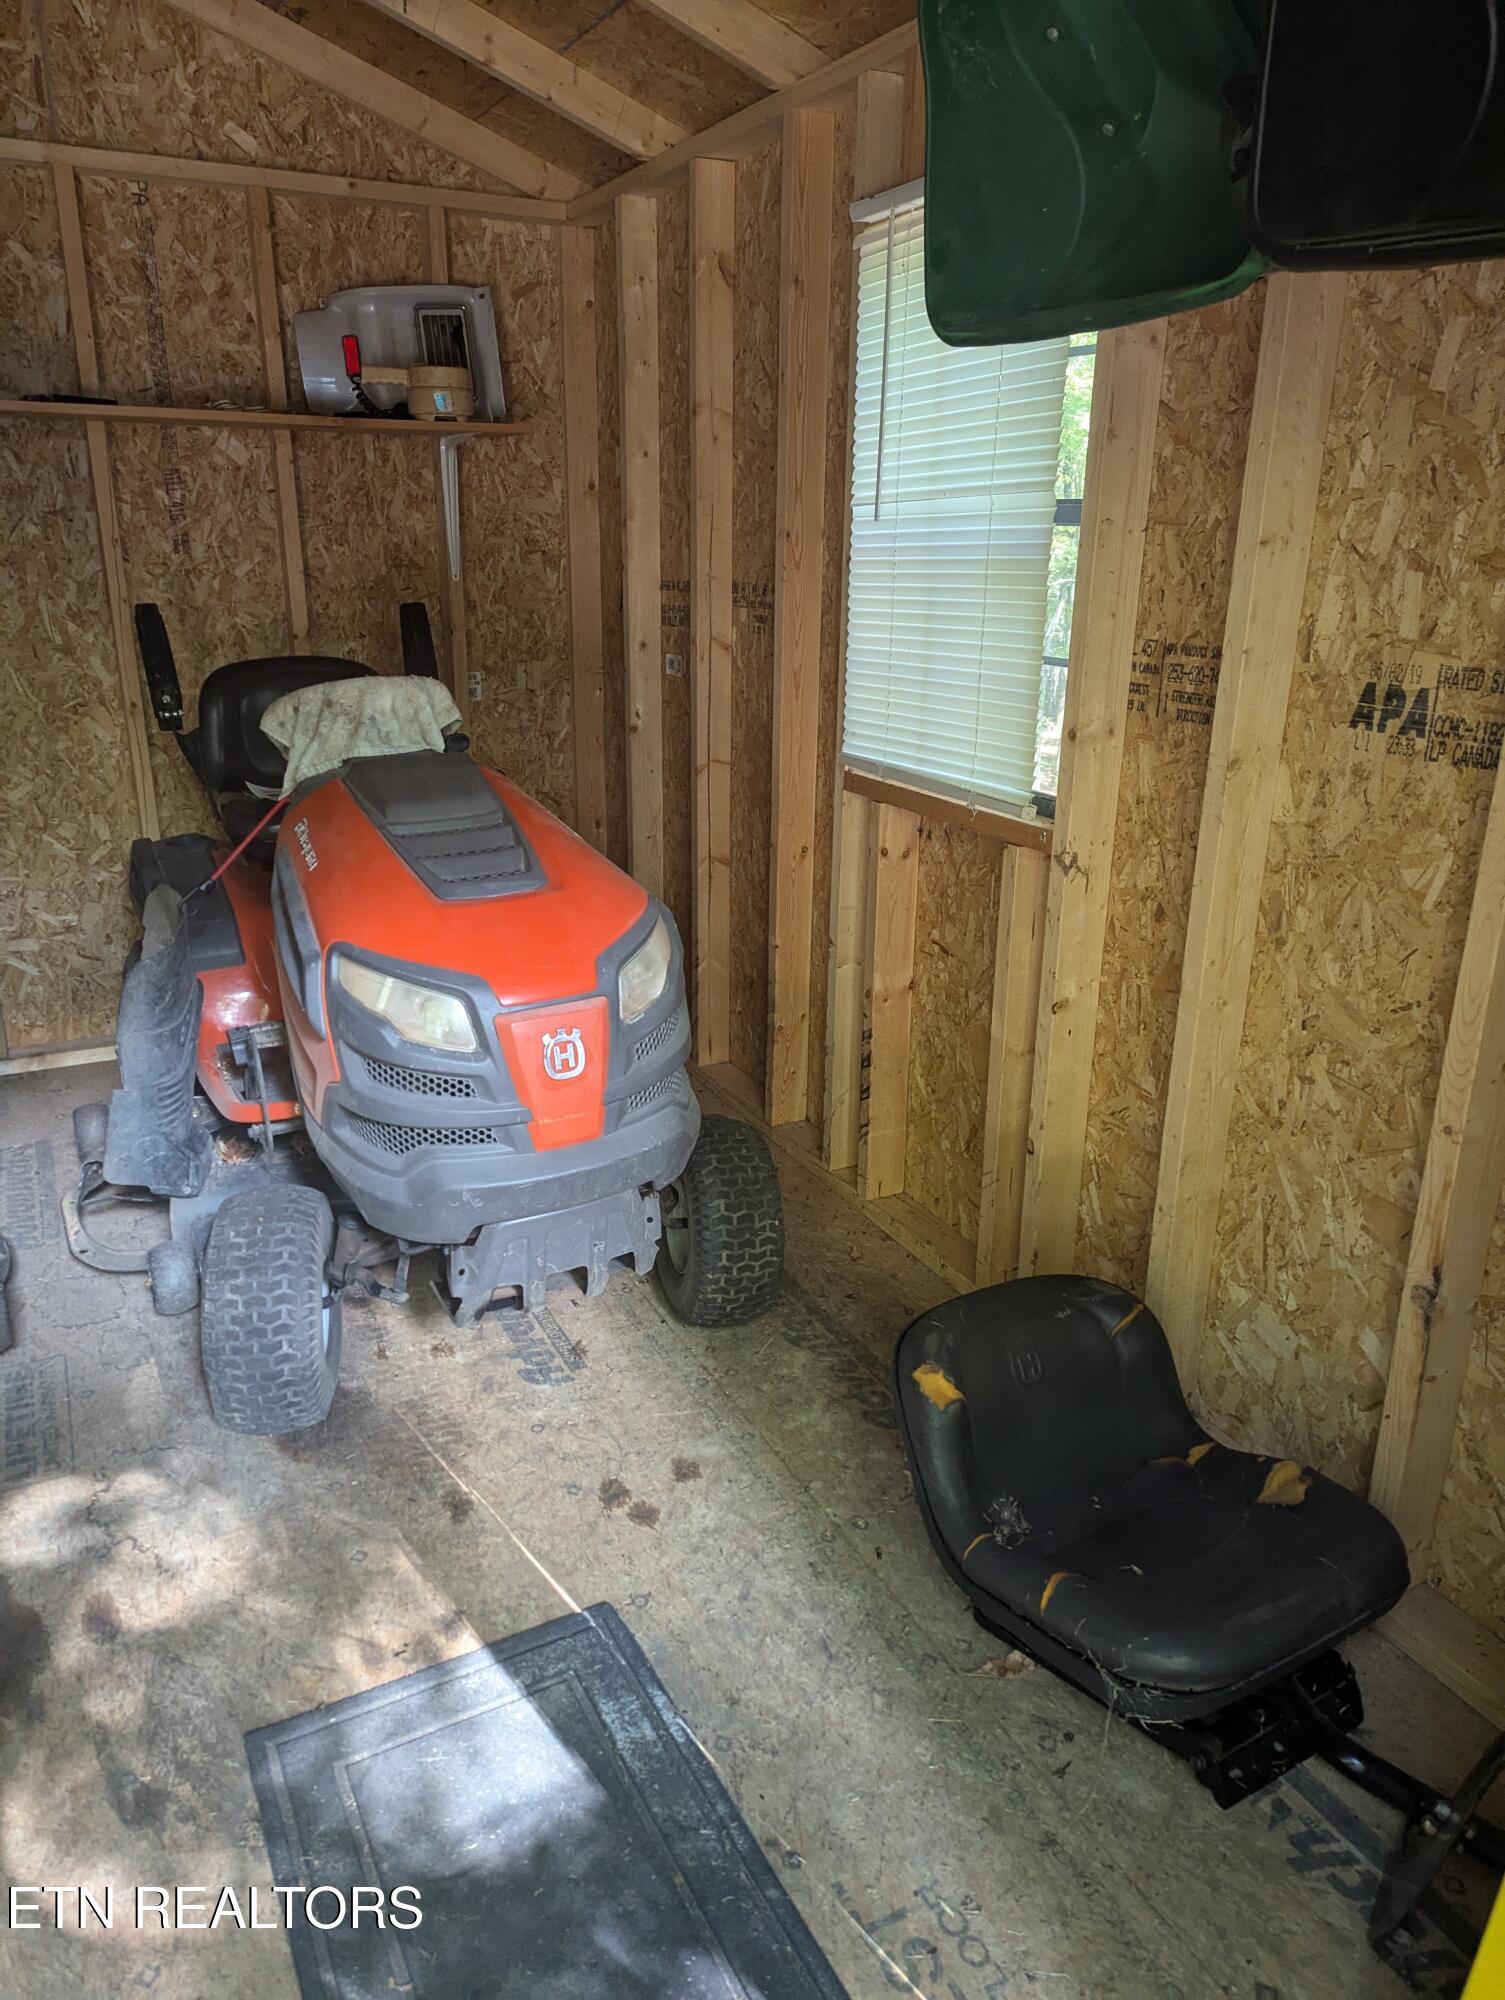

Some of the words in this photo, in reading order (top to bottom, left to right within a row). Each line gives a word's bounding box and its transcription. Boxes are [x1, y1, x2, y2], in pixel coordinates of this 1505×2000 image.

[1441, 666, 1485, 692] RATED
[1348, 681, 1430, 739] APA
[1428, 736, 1447, 763] LP
[1452, 742, 1499, 770] CANADA
